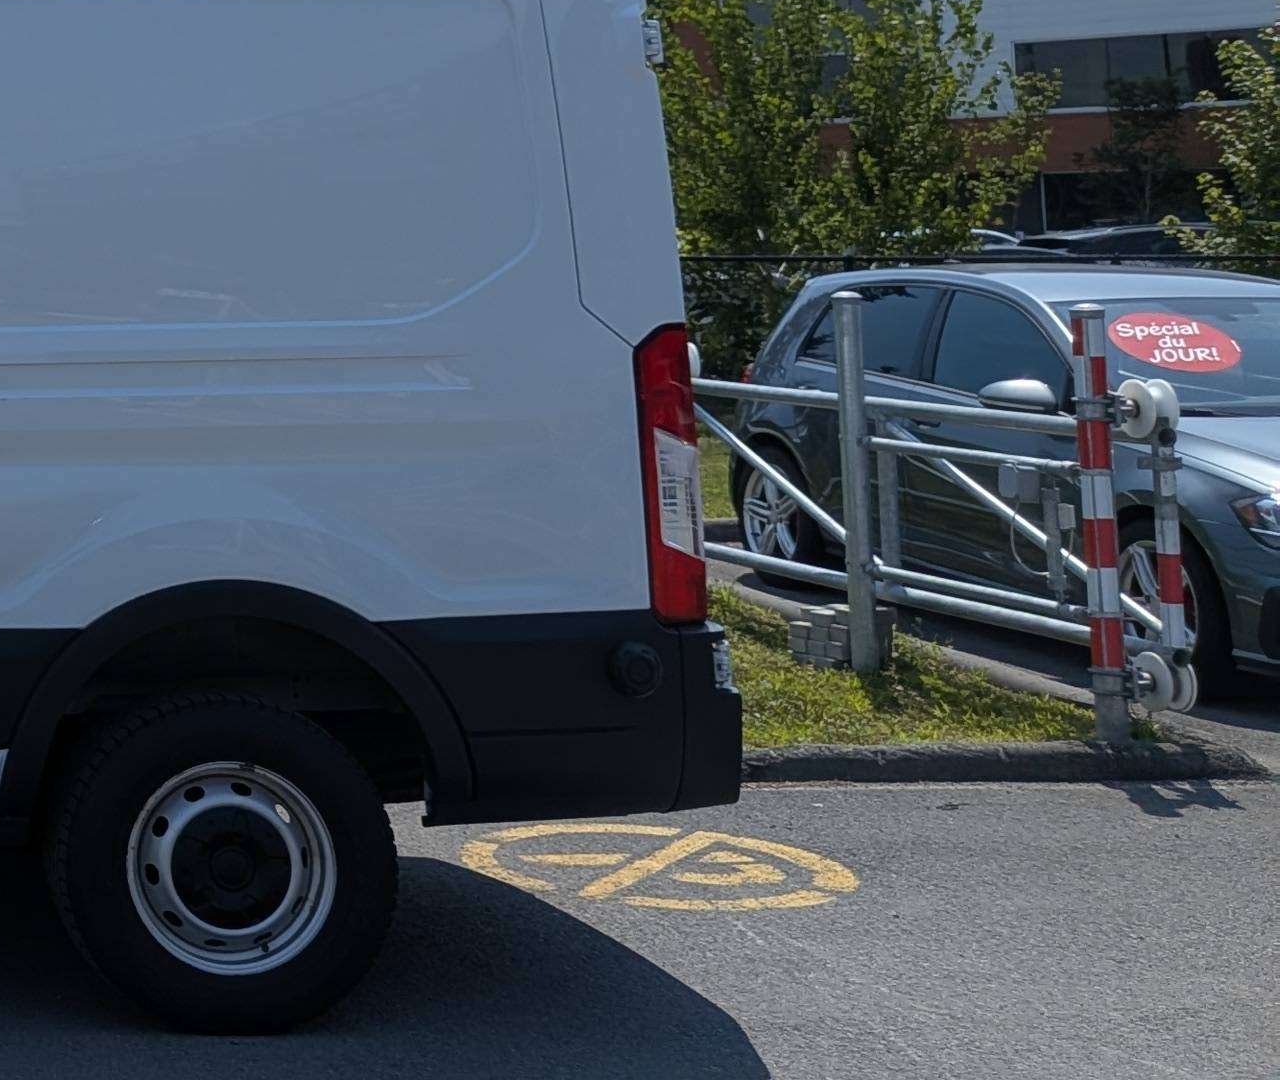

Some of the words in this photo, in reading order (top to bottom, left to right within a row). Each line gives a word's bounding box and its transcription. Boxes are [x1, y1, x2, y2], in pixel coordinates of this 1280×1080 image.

[1115, 321, 1201, 341] Spécial
[1158, 335, 1187, 348] du
[1149, 346, 1222, 363] JOUR!
